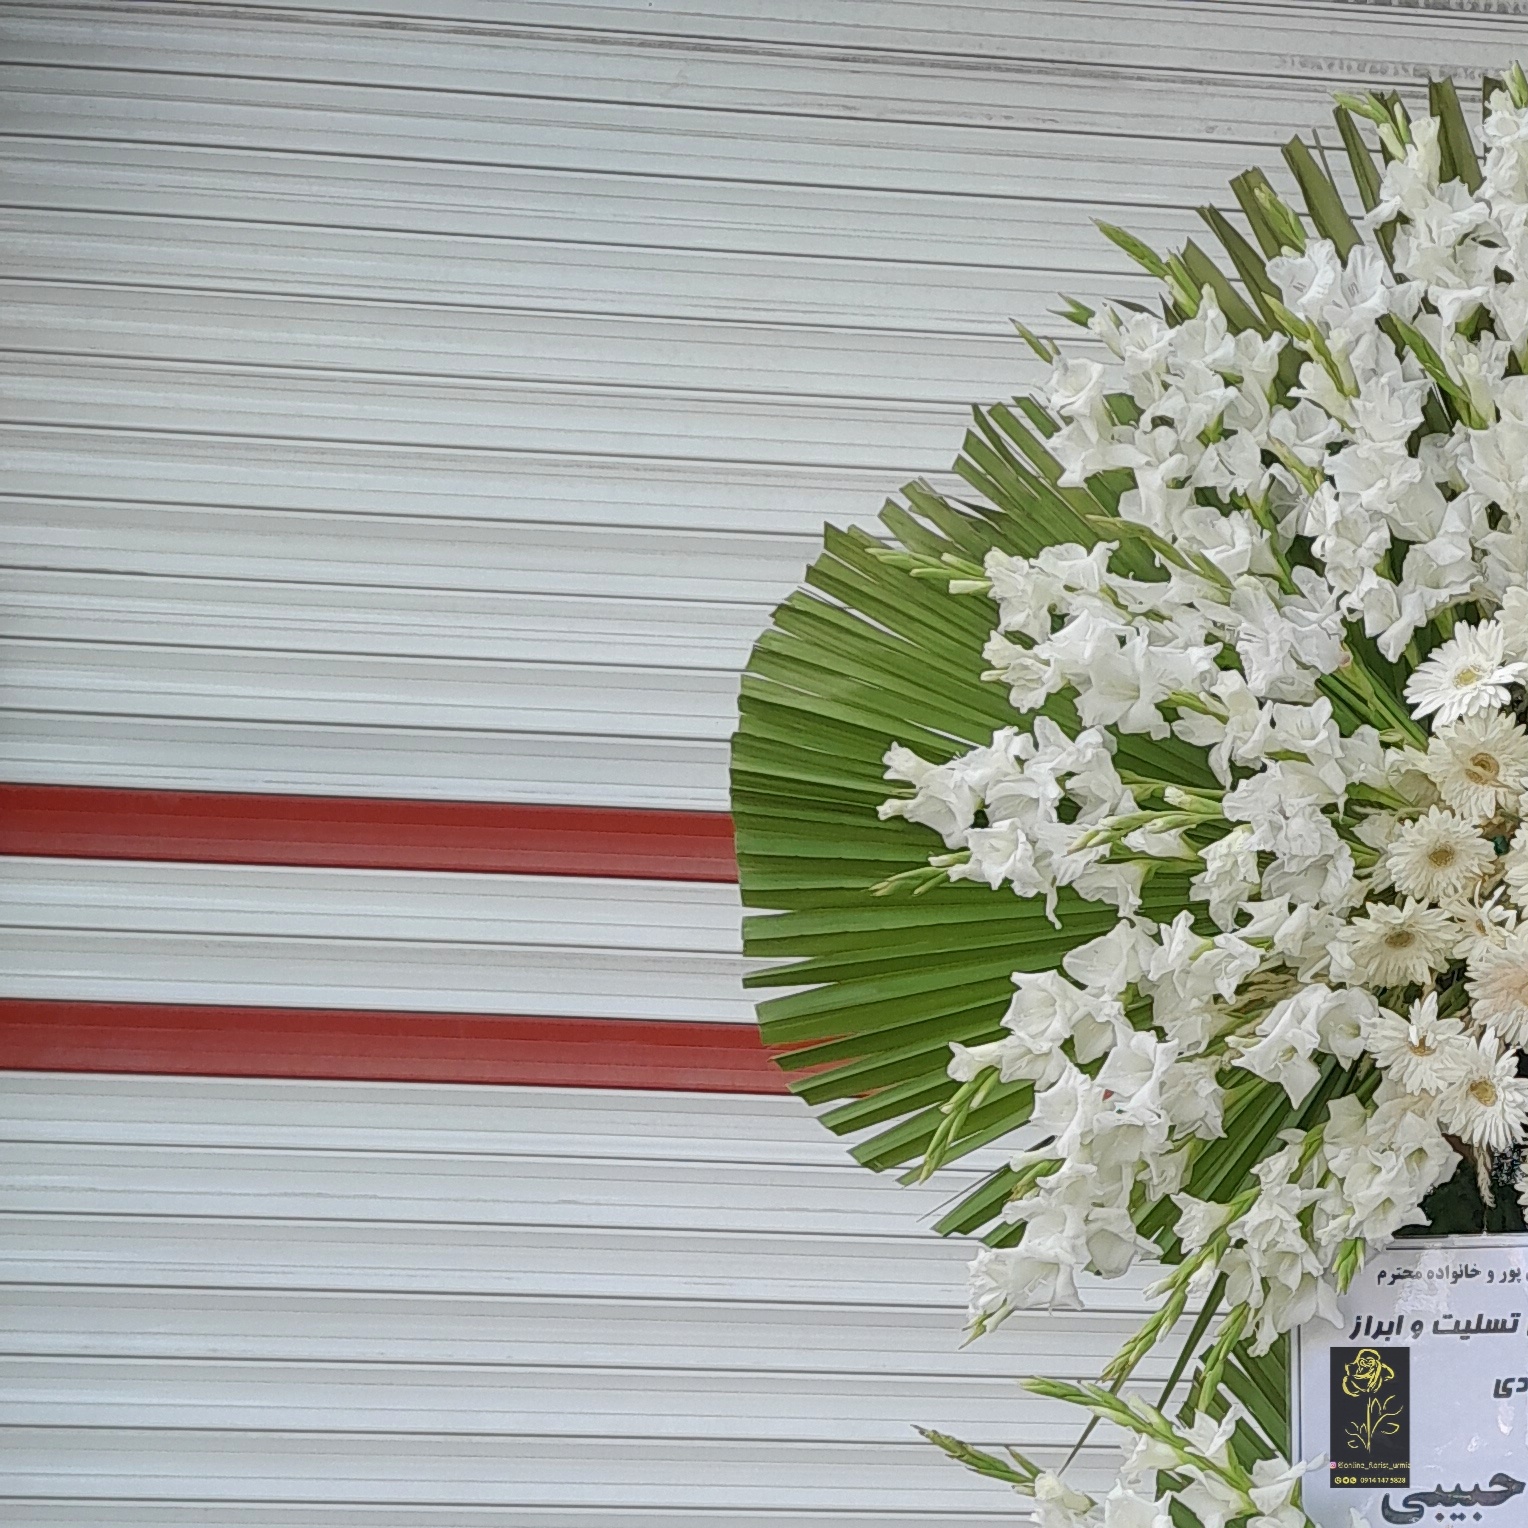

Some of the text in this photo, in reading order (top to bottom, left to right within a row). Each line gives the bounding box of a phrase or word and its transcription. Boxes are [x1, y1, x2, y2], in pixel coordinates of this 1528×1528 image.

[1377, 1267, 1423, 1286] محترم
[1426, 1263, 1482, 1285] خانواده
[1486, 1269, 1495, 1284] و
[1498, 1266, 1522, 1284] پور
[1349, 1314, 1405, 1342] ابراز
[1410, 1319, 1424, 1340] و
[1432, 1313, 1522, 1341] تسلیت
[1381, 1472, 1526, 1524] حبیبی
